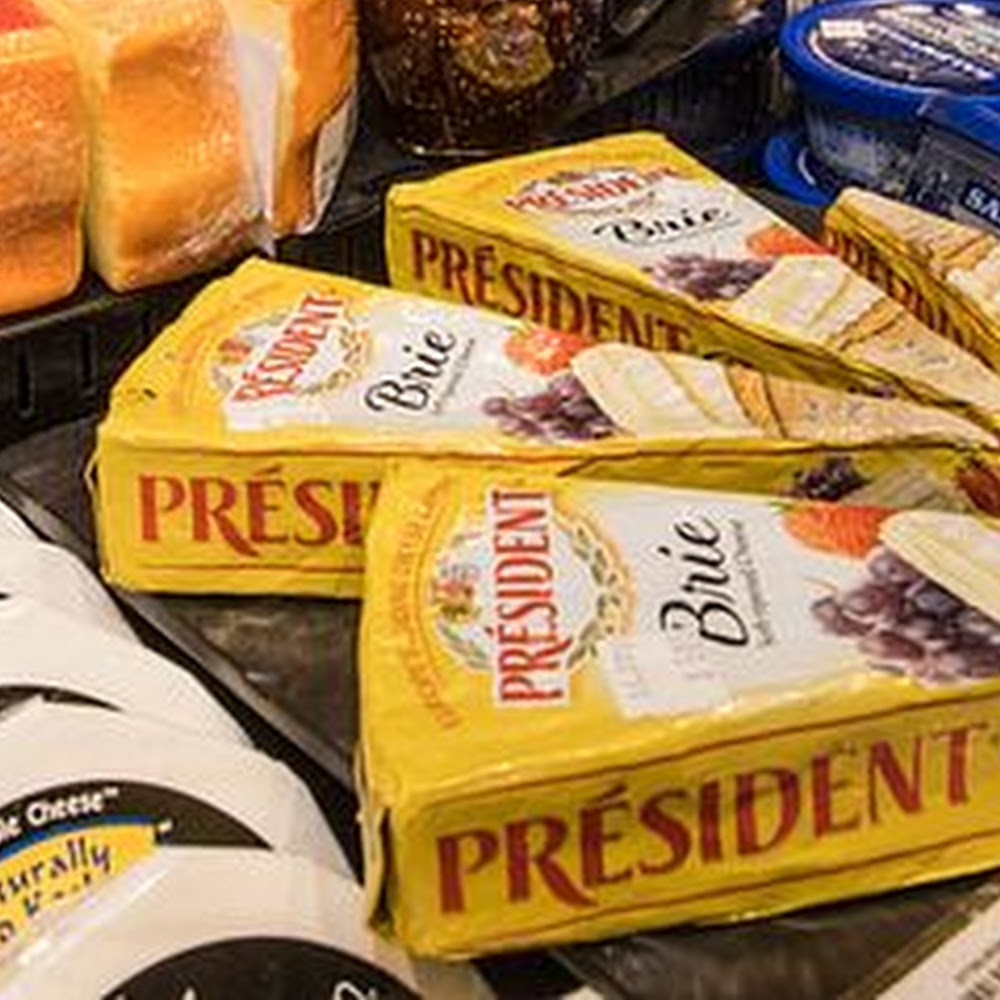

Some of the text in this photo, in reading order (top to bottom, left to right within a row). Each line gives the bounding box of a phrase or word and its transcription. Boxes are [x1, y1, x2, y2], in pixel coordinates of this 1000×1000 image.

[592, 206, 731, 244] Brie
[411, 228, 693, 354] PRÉSIDENT
[364, 328, 457, 413] Brie
[484, 490, 573, 702] PRÉSIDENT
[656, 516, 749, 647] Brie
[436, 720, 988, 915] PRÉSIDENT
